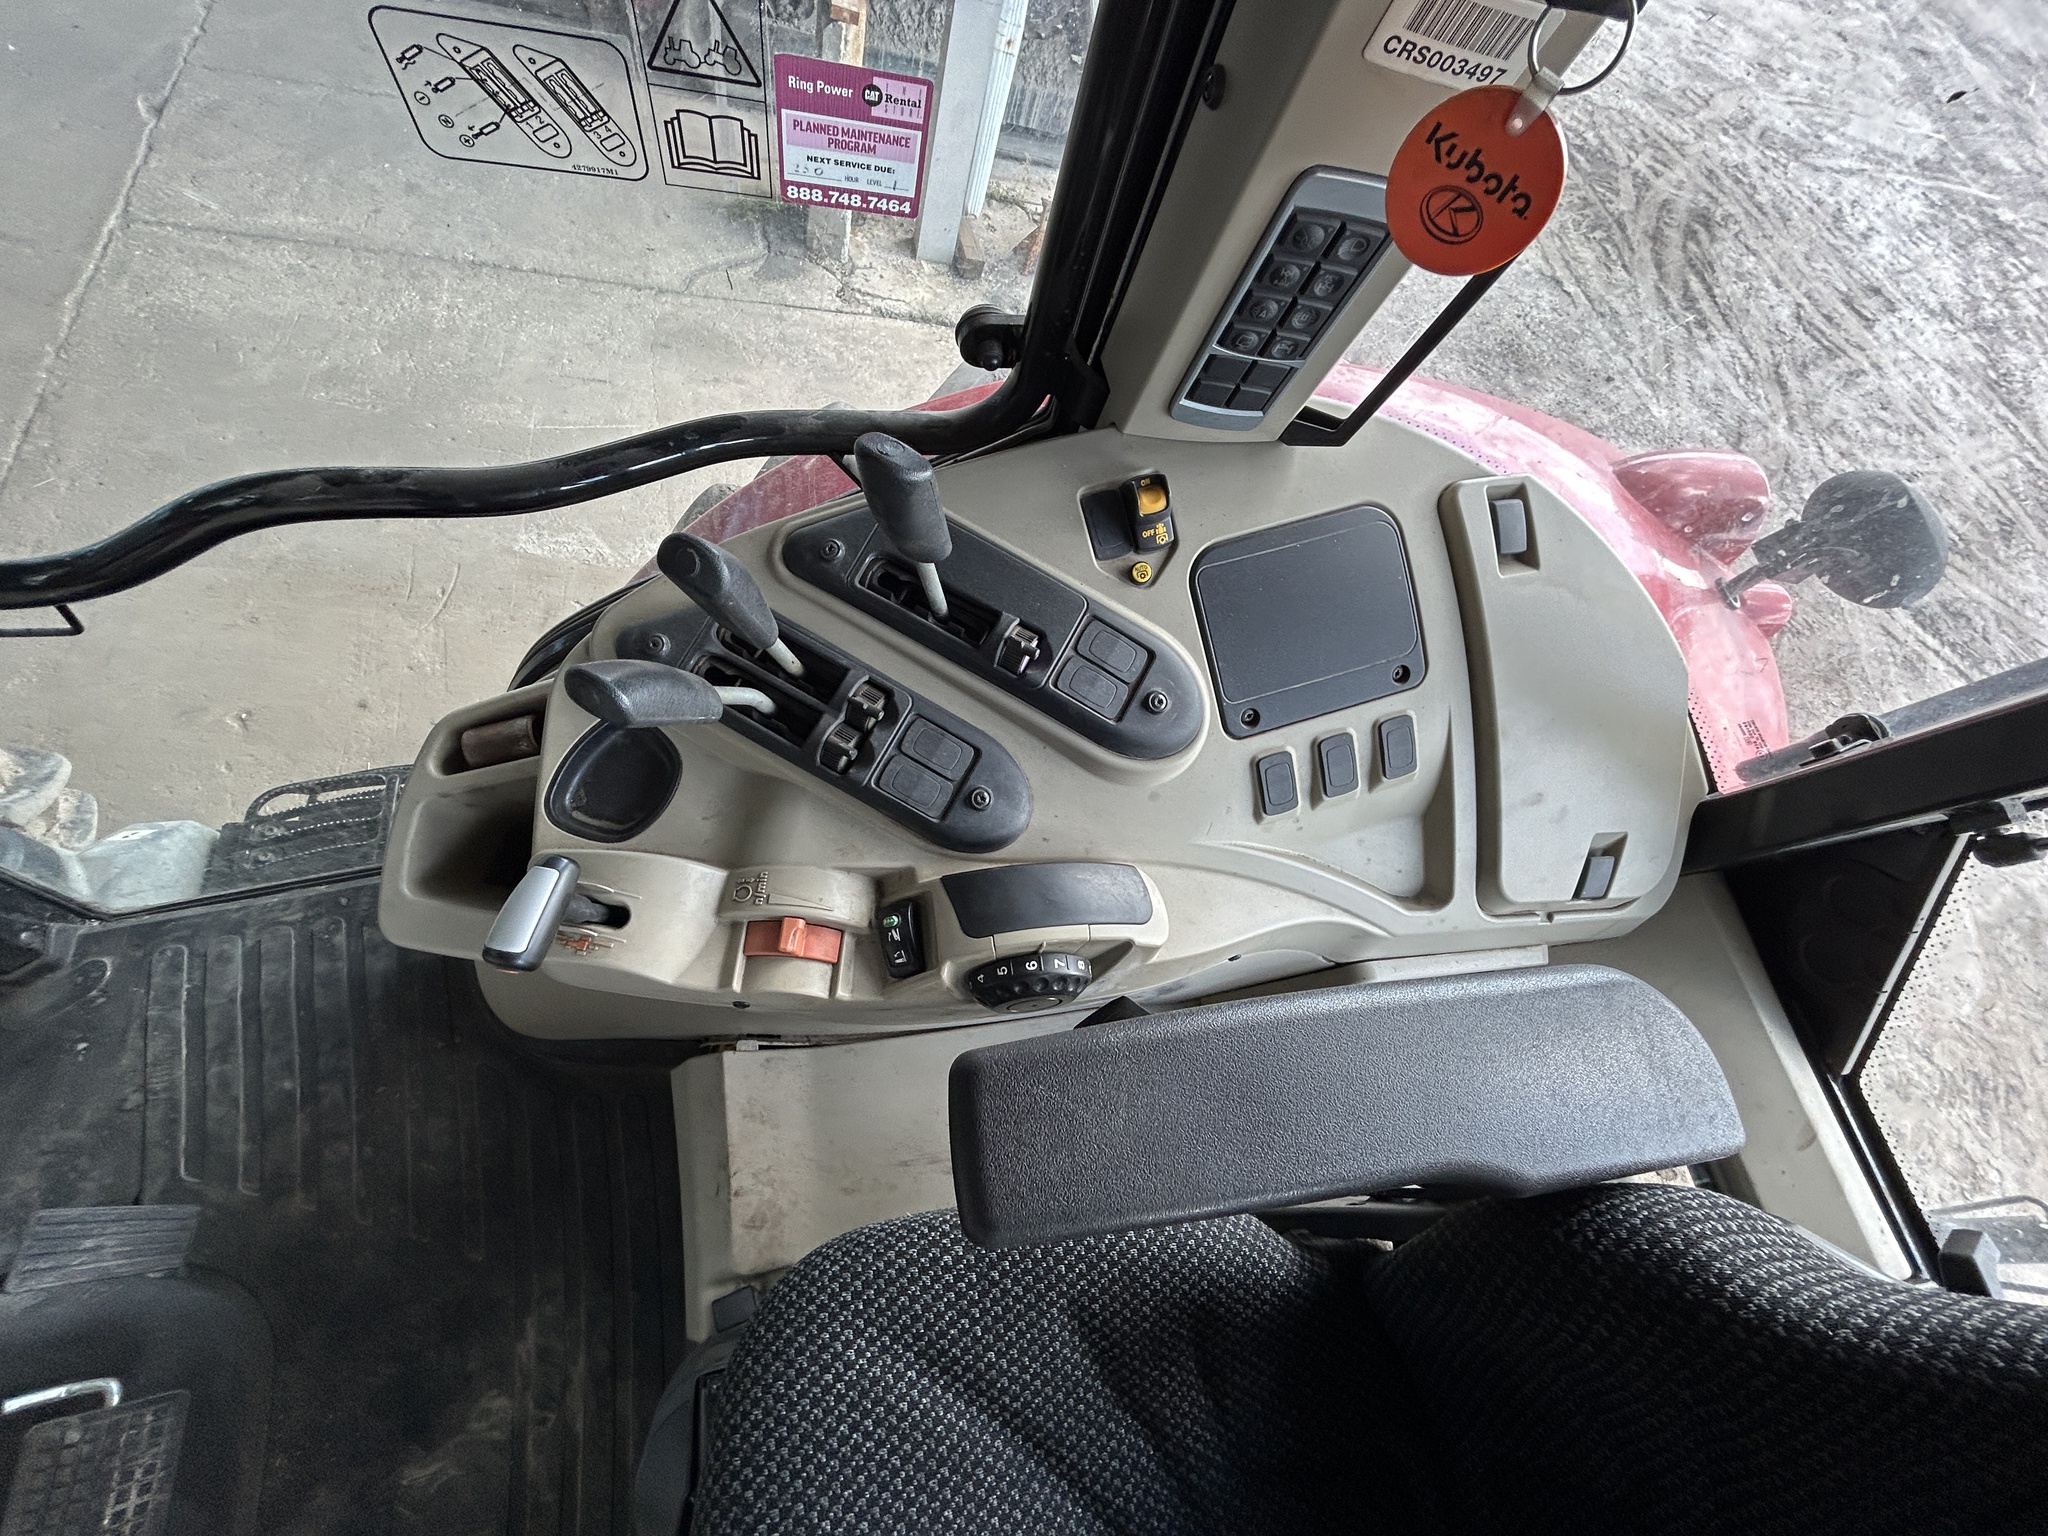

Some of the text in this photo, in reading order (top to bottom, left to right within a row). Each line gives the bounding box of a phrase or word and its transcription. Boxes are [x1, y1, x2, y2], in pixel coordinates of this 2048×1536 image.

[1383, 35, 1508, 85] CRS003497
[788, 75, 853, 98] Ring Power
[864, 89, 922, 108] CAT Rental
[526, 121, 534, 129] 1
[534, 115, 545, 124] 2
[593, 131, 602, 139] 3
[604, 125, 612, 133] 4
[793, 119, 911, 148] PLANNED MAINTENANCE
[827, 137, 877, 155] PROGRAM
[806, 155, 895, 174] NEXT SERVICE DUE:
[1425, 121, 1533, 220] Kubota
[844, 175, 859, 183] HOUR
[866, 178, 883, 187] LEVEL
[787, 185, 911, 214] 888.748.7464
[1142, 529, 1155, 538] OFF
[997, 966, 1008, 976] 5
[1025, 960, 1038, 971] 6
[1054, 958, 1066, 969] 7
